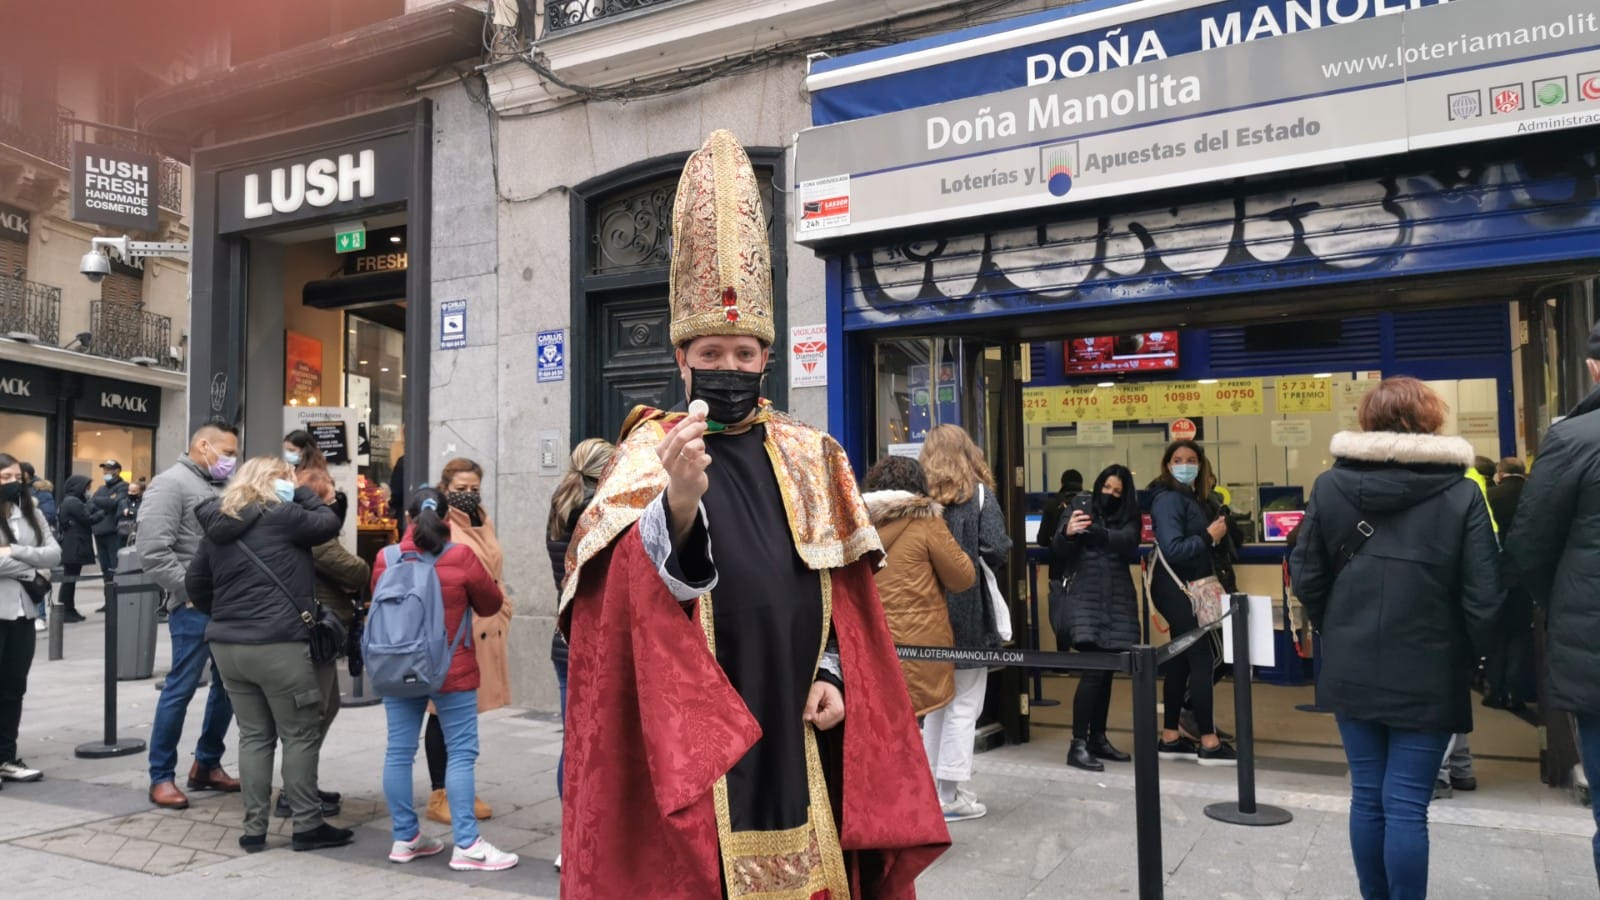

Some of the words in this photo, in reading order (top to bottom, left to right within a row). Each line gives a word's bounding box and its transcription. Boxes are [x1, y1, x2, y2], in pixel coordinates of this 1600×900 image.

[1321, 12, 1599, 78] www.loteriamanolit
[1027, 28, 1168, 87] DOÑA
[927, 106, 1016, 150] Doña
[1027, 73, 1200, 132] Manolita
[941, 168, 1018, 195] Loterías
[1024, 166, 1036, 186] y
[1085, 141, 1186, 173] Apuestas
[1194, 130, 1229, 154] del
[1236, 117, 1321, 147] Estado
[85, 155, 149, 182] LUSH
[85, 173, 149, 197] FRESH
[244, 149, 375, 219] LUSH
[85, 188, 149, 207] HANDMADE
[85, 199, 149, 217] COSMETICS
[356, 252, 408, 271] FRESH
[1062, 396, 1099, 407] 41710
[1112, 393, 1148, 405] 26590
[1164, 391, 1201, 403] 10989
[1215, 388, 1255, 400] 00750
[1290, 390, 1325, 399] PREMIO
[896, 648, 1024, 662] WWW.LOTERIAMANOLITA.COM
